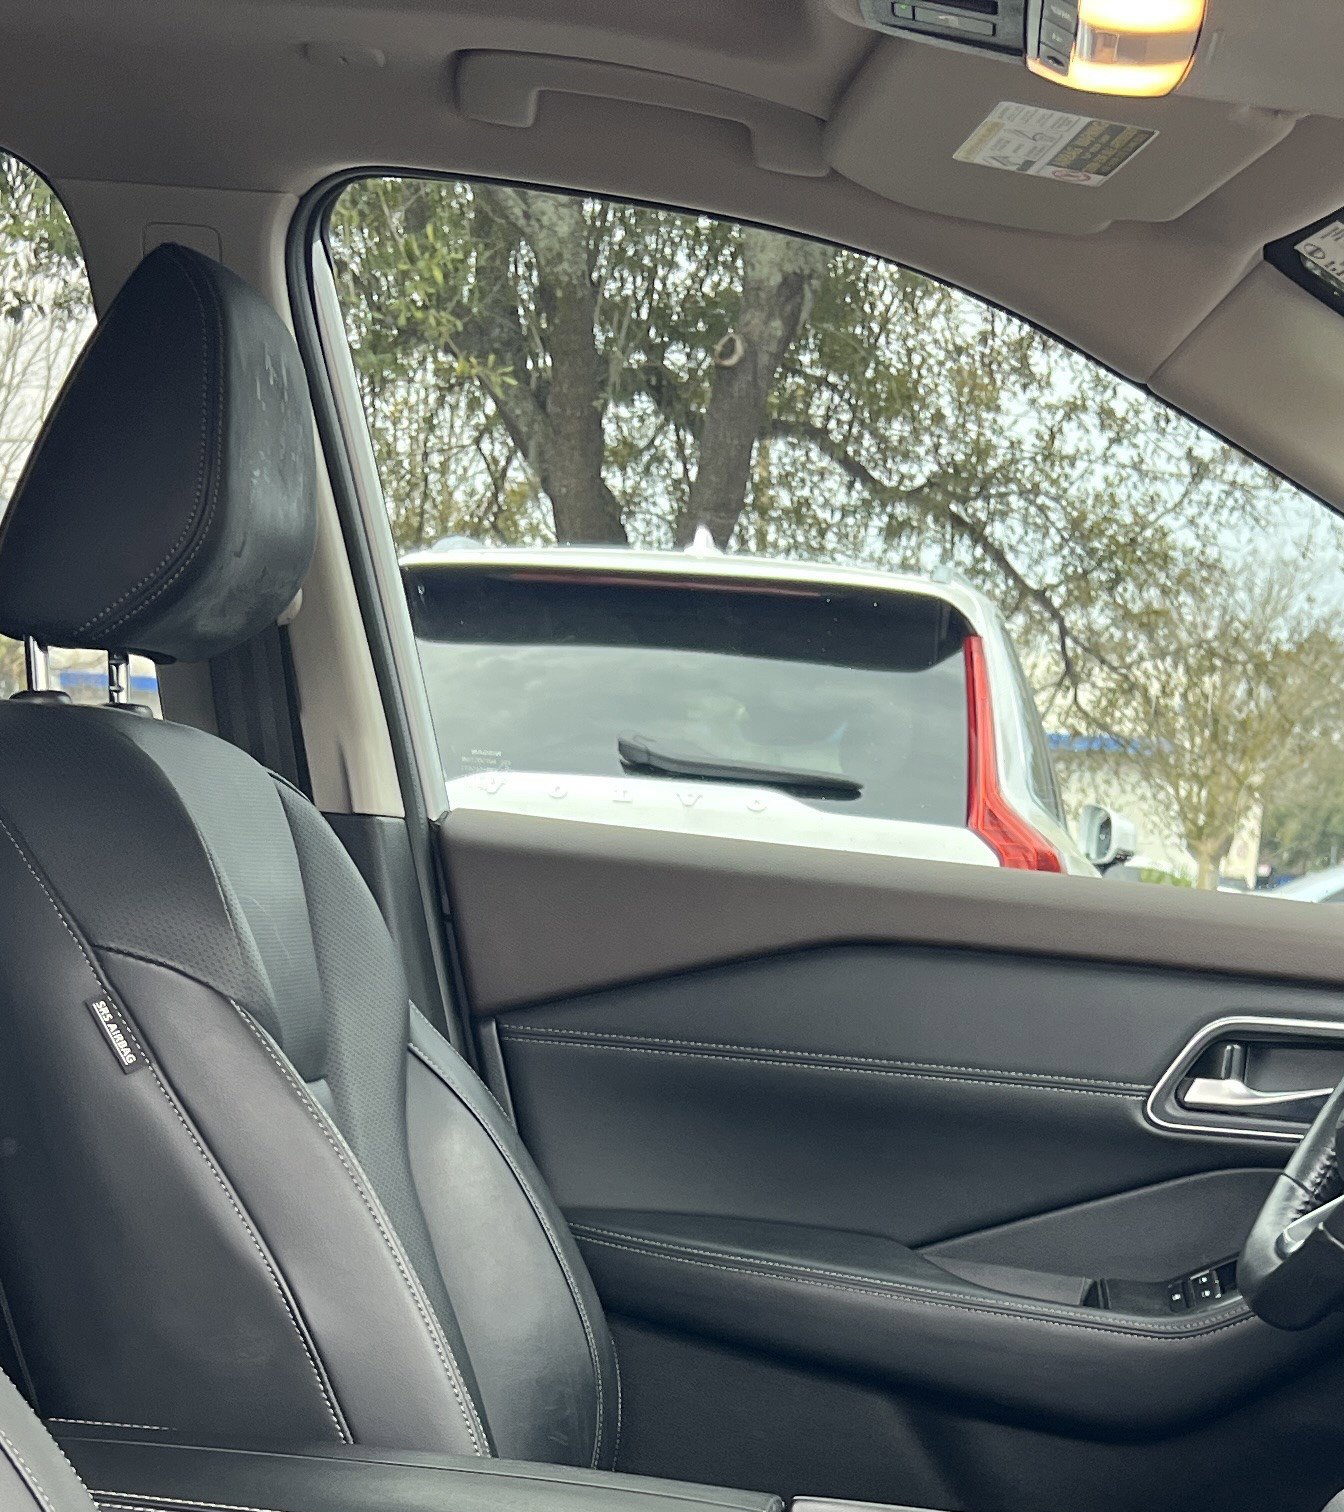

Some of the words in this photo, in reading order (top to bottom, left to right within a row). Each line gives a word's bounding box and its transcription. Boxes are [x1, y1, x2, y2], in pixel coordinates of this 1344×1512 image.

[476, 776, 767, 813] VOLVO
[96, 1000, 114, 1022] SRS
[107, 1022, 137, 1064] AIRBAG
